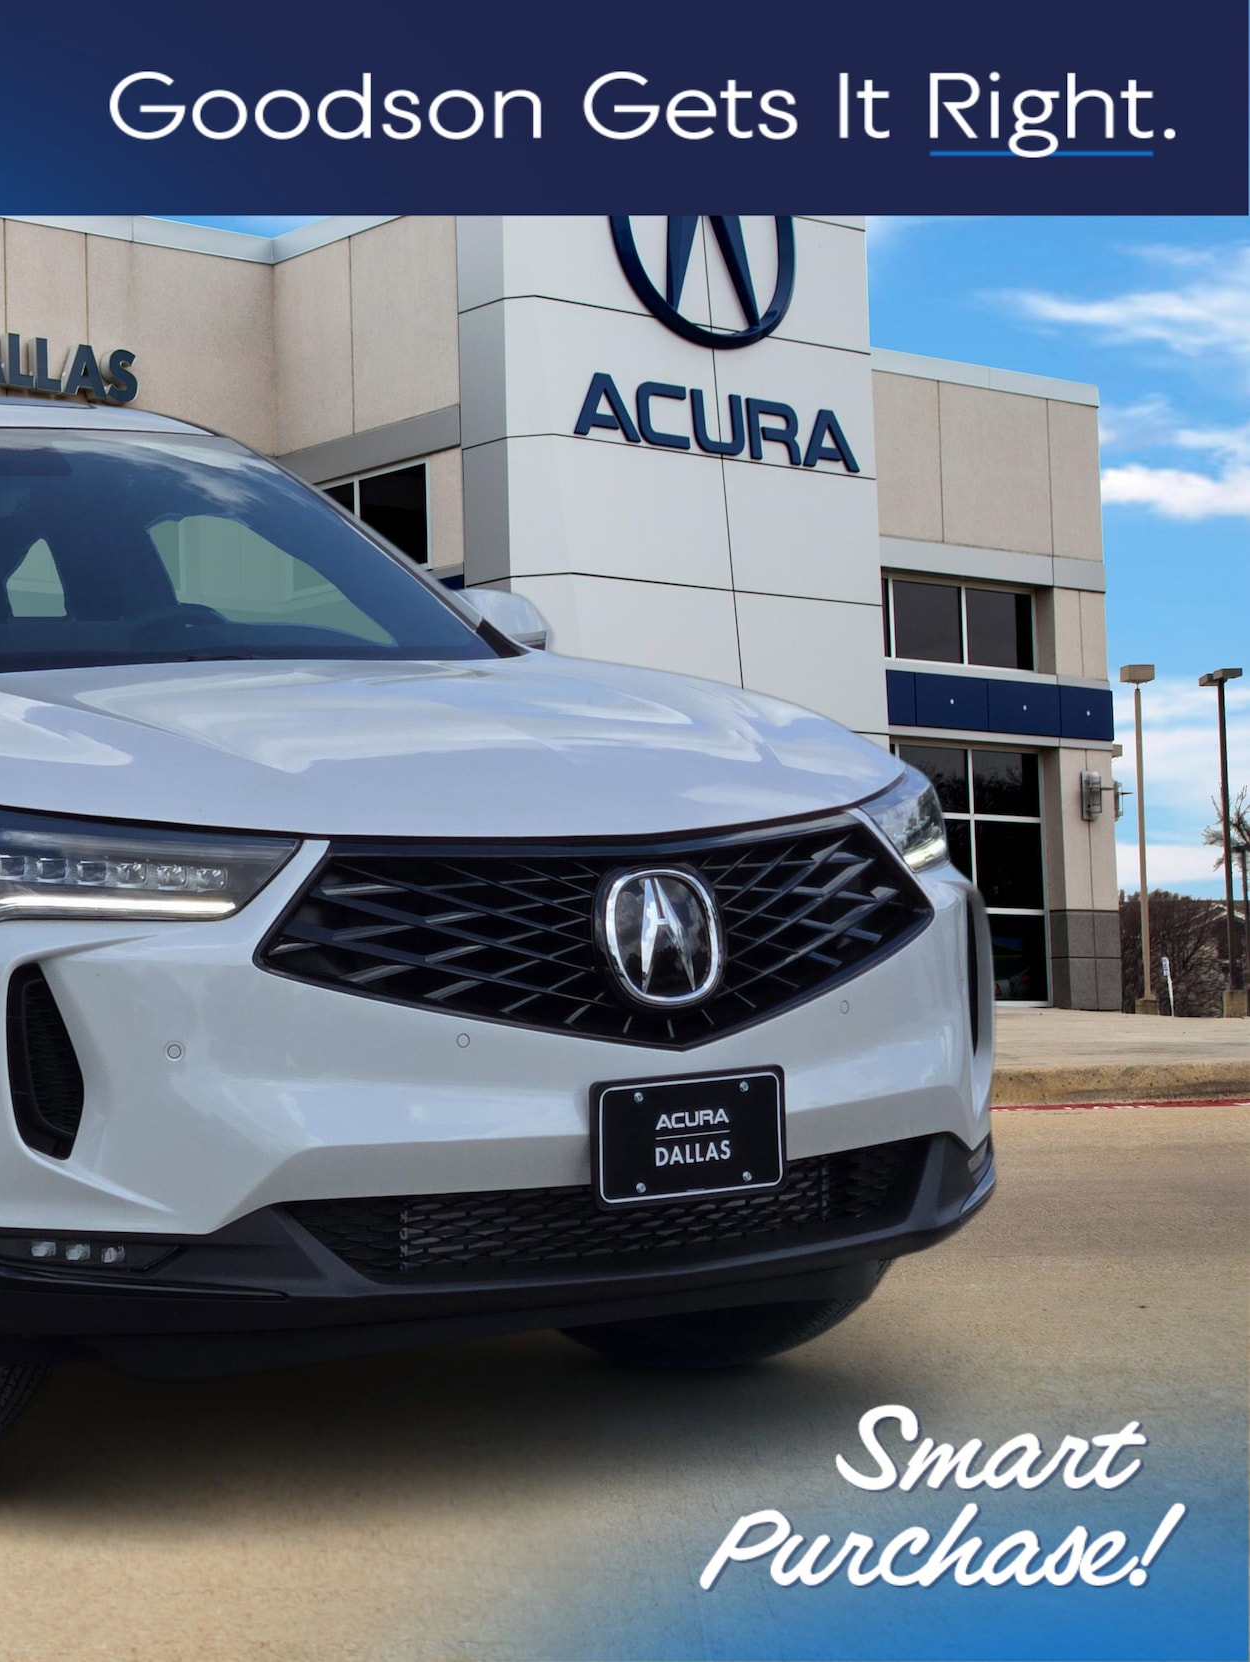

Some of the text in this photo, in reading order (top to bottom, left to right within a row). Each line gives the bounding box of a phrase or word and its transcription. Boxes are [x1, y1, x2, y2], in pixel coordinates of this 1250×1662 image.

[573, 372, 860, 473] ACURA
[655, 1108, 730, 1131] ACURA
[654, 1139, 732, 1167] DALLAS
